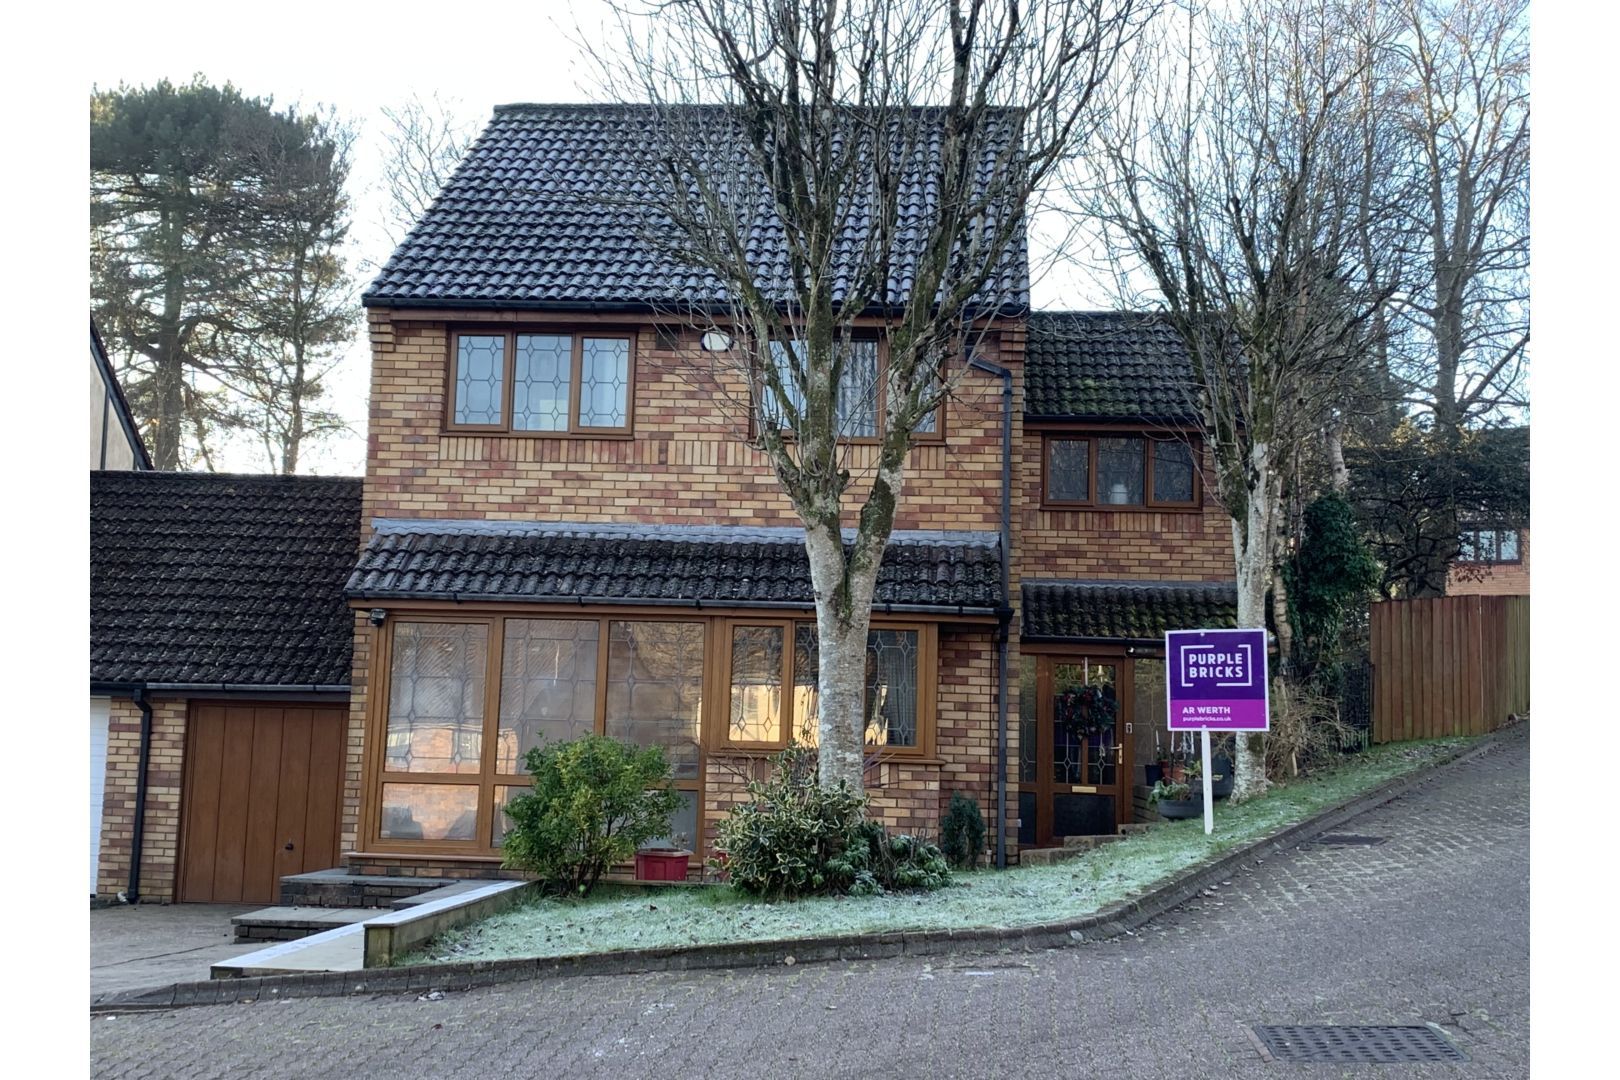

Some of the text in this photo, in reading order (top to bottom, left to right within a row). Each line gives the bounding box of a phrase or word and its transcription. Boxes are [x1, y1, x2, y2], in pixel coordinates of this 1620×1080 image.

[1188, 653, 1243, 665] PURPLE
[1189, 666, 1243, 678] BRICKS
[1182, 706, 1231, 714] AR WERTH
